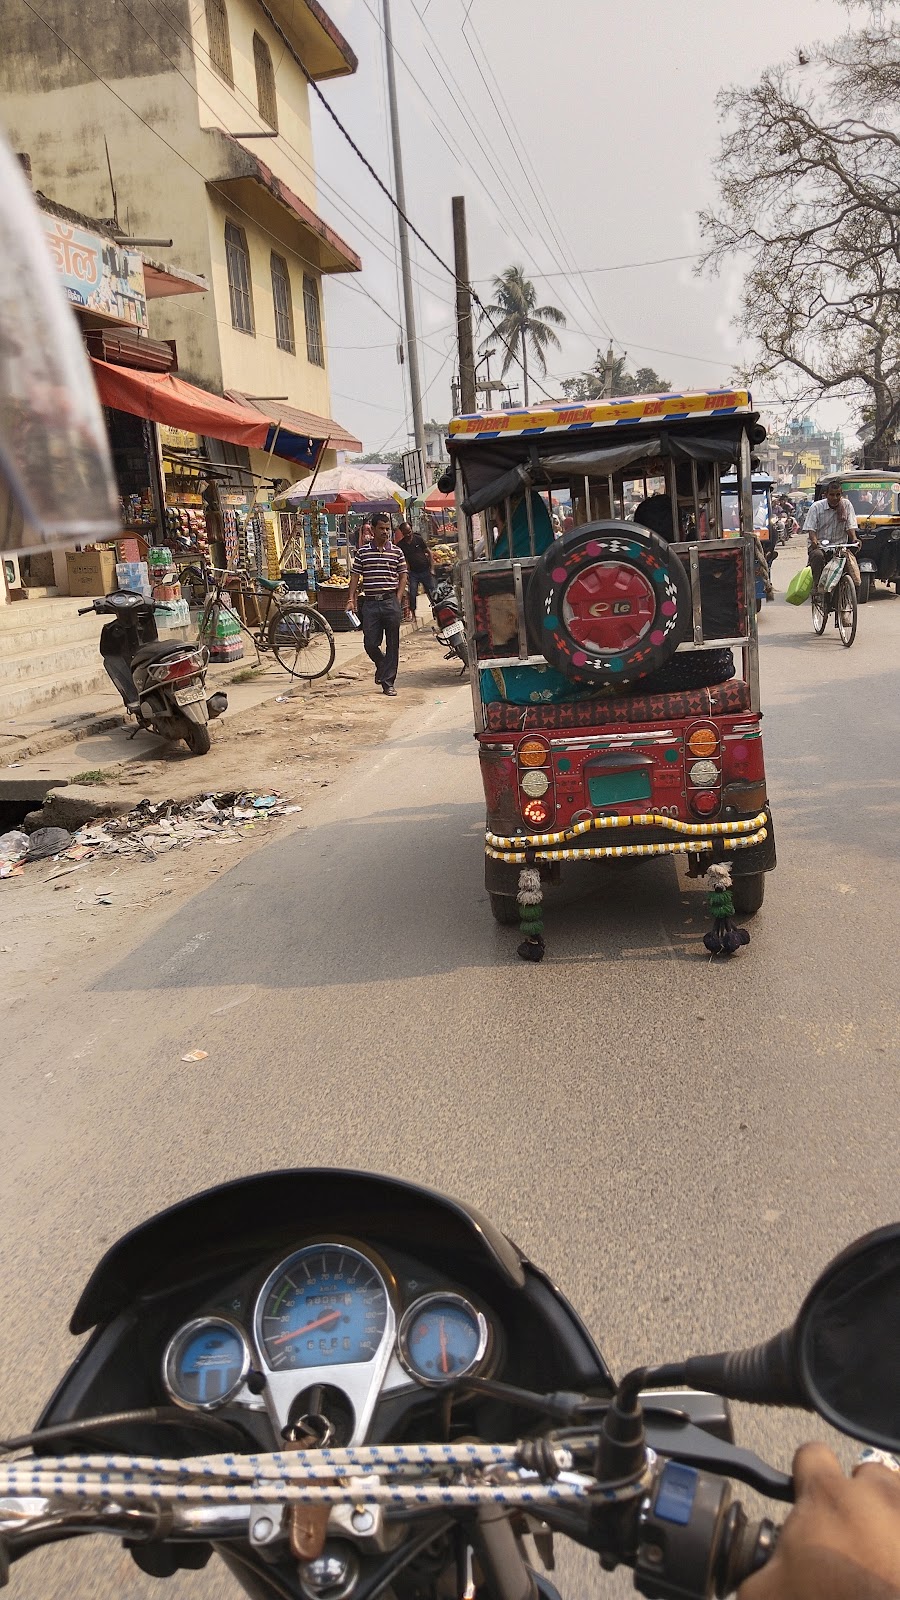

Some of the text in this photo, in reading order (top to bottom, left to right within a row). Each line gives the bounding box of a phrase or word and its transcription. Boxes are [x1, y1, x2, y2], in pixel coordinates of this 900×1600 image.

[466, 416, 510, 432] SABKA
[557, 408, 596, 424] MALIK
[643, 400, 666, 415] EK
